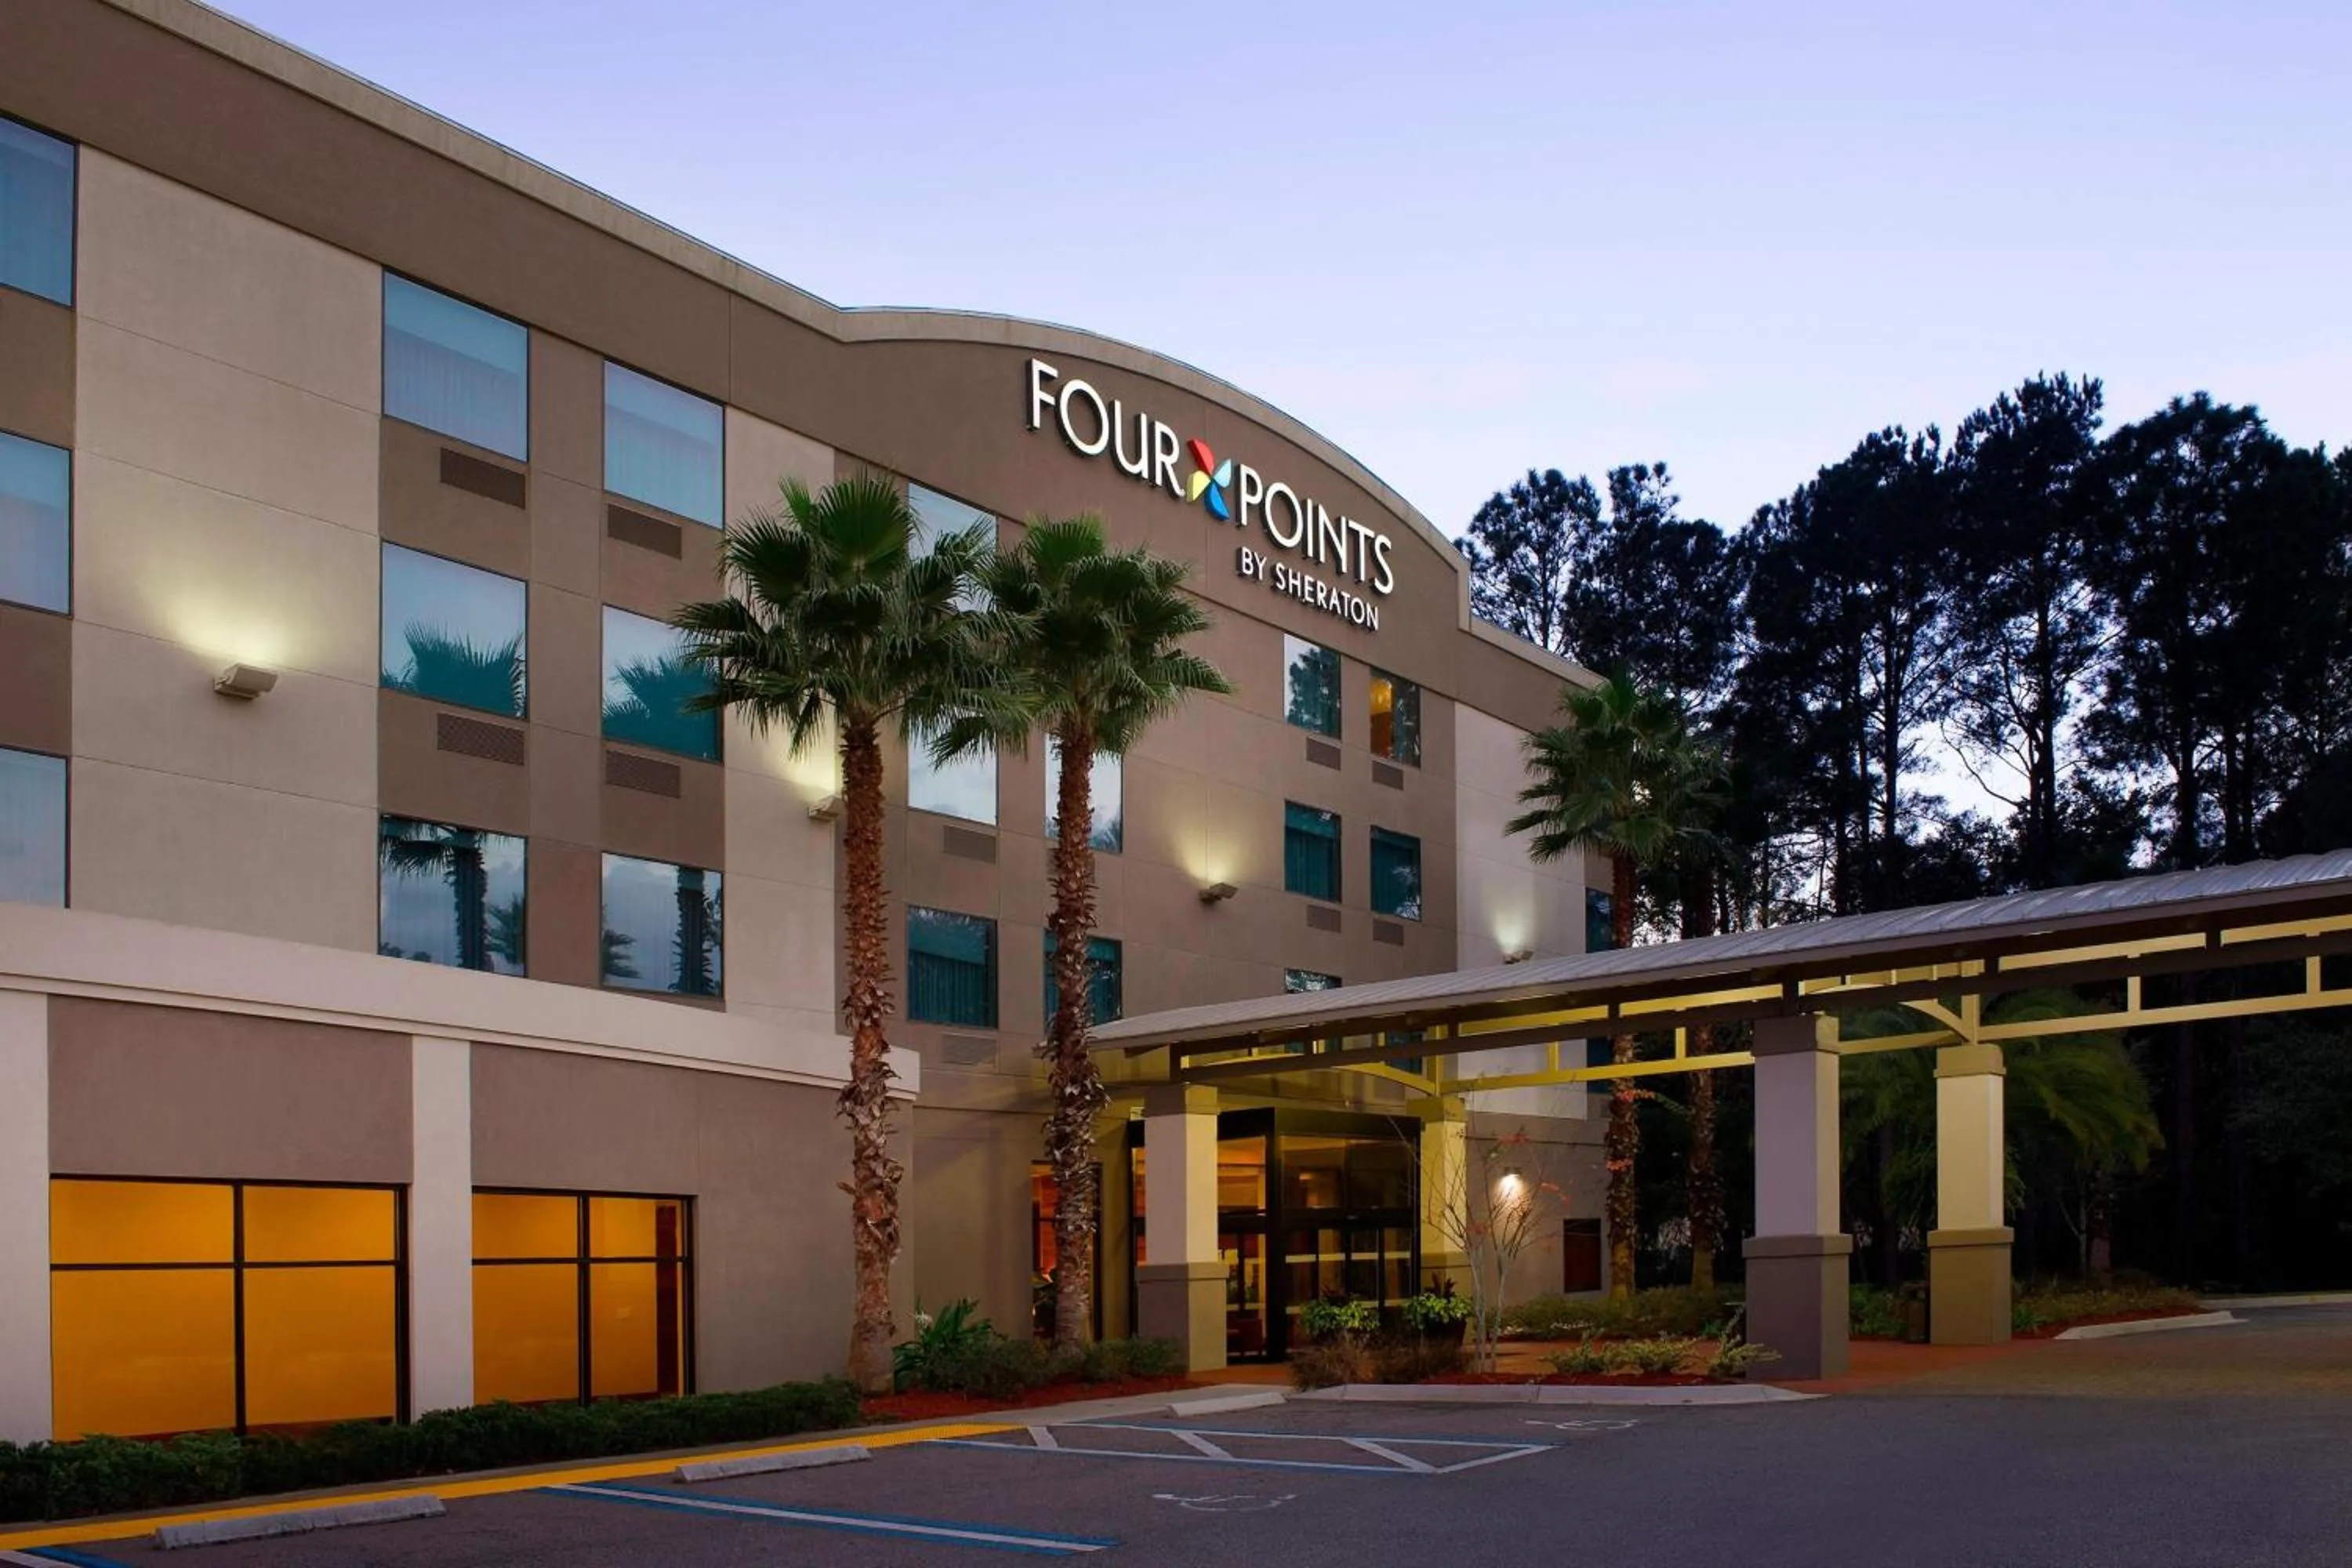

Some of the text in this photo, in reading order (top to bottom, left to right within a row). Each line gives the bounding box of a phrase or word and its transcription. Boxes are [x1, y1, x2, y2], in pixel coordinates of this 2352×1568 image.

[1030, 358, 1394, 595] FOUR POINTS
[1241, 546, 1379, 631] BY SHERATON
